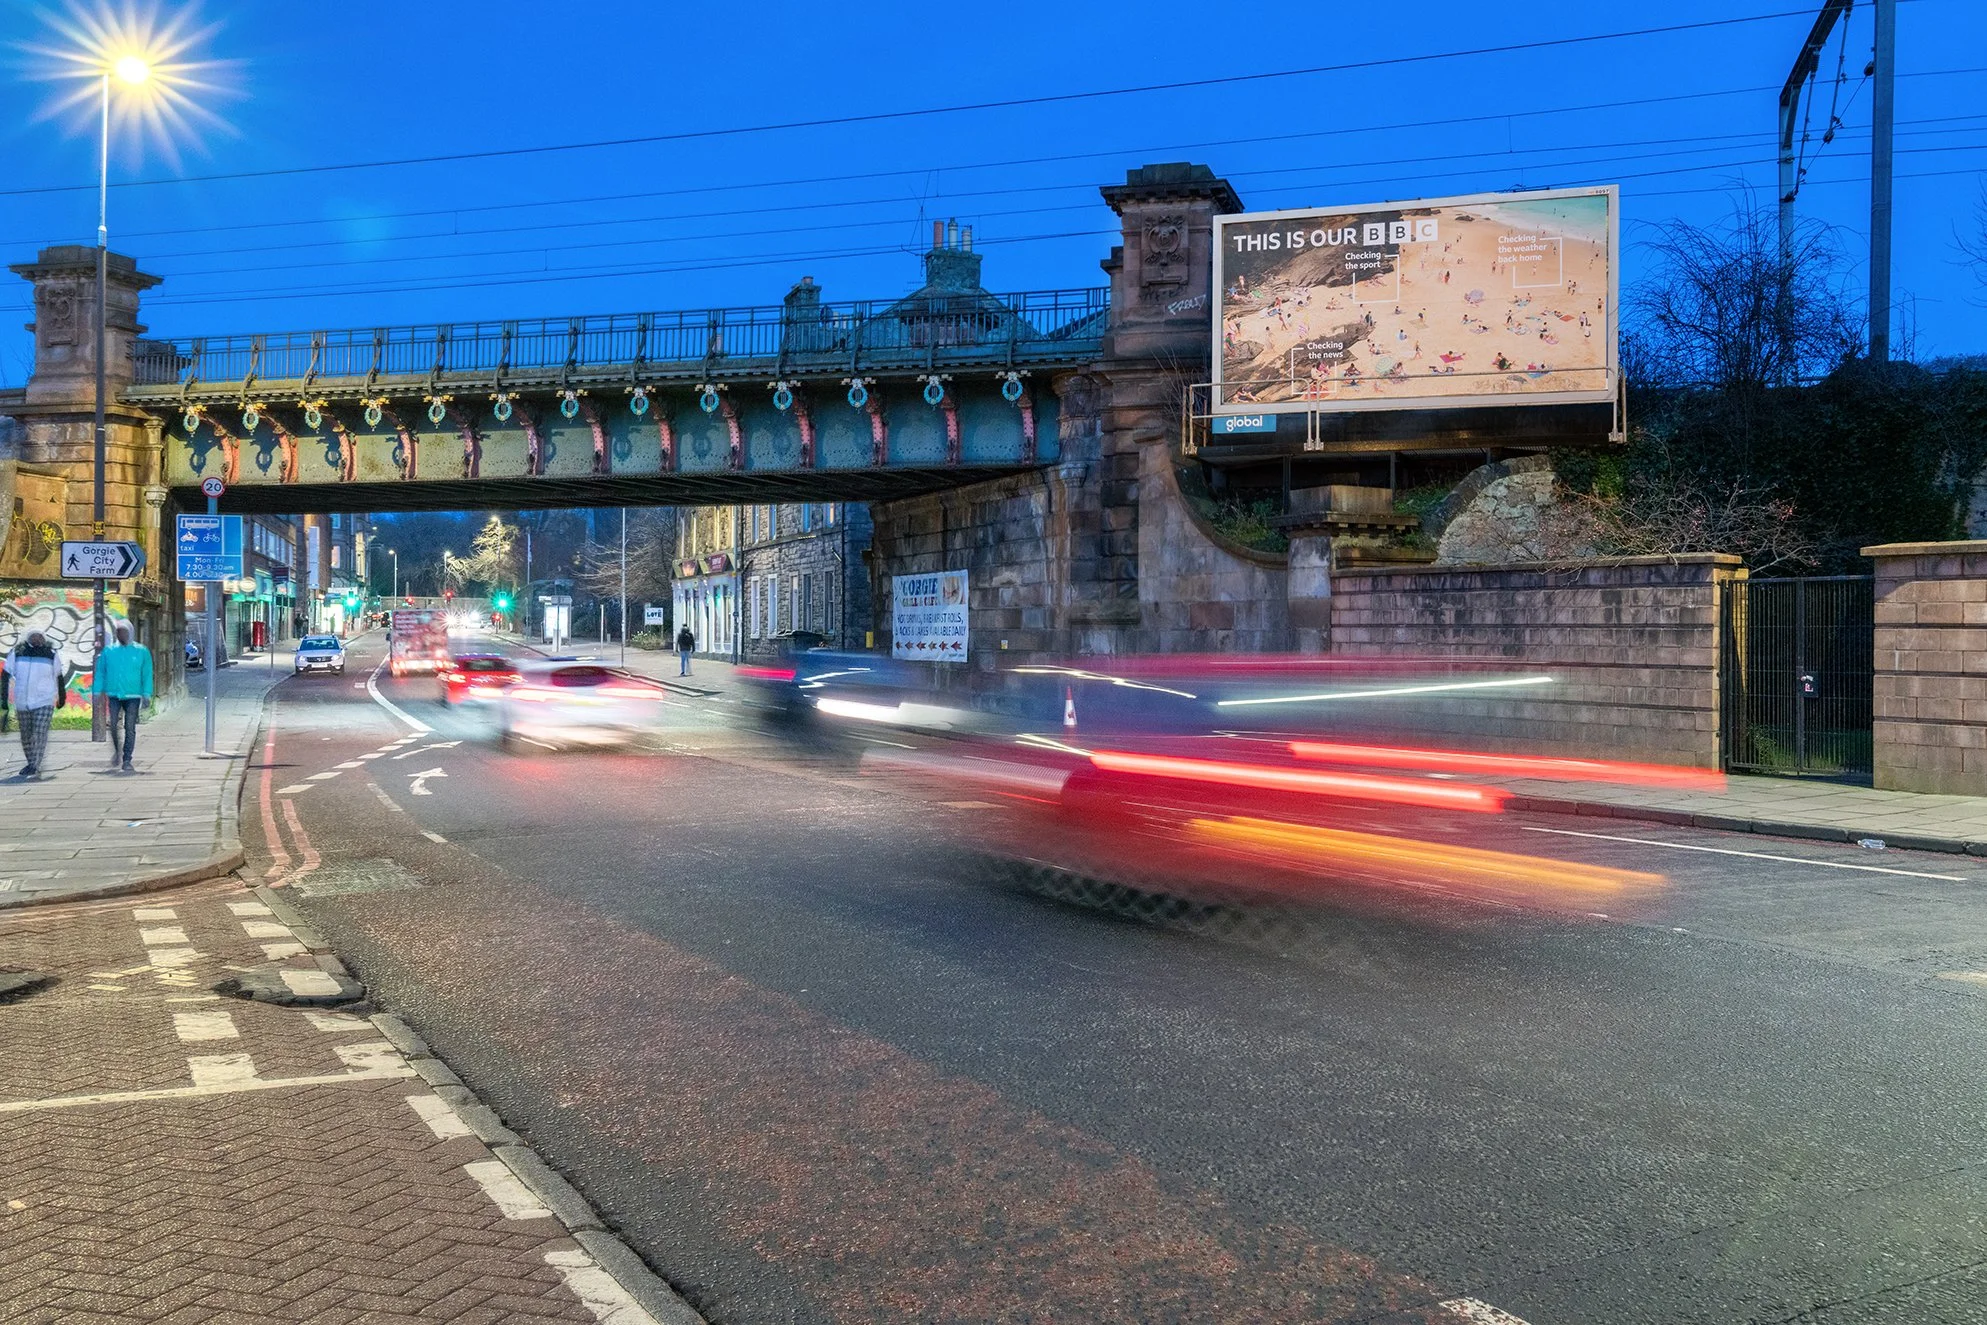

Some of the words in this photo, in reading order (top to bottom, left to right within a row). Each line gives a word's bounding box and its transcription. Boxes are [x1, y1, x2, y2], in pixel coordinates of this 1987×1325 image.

[1233, 233, 1281, 252] THIS
[1286, 231, 1305, 249] IS
[1310, 228, 1358, 247] OUR
[1366, 222, 1435, 243] BBC
[1498, 234, 1537, 244] Checking
[1498, 245, 1512, 253] the
[1514, 243, 1548, 252] weather
[1345, 251, 1381, 260] Checking
[1498, 255, 1518, 263] back
[1345, 262, 1358, 270] the
[1359, 261, 1381, 270] sport
[1307, 341, 1343, 350] Checking
[1308, 351, 1322, 359] the
[1226, 415, 1263, 432] global
[206, 482, 222, 492] 20
[82, 546, 116, 556] Gorgie
[93, 556, 115, 566] City
[90, 566, 115, 575] Farm
